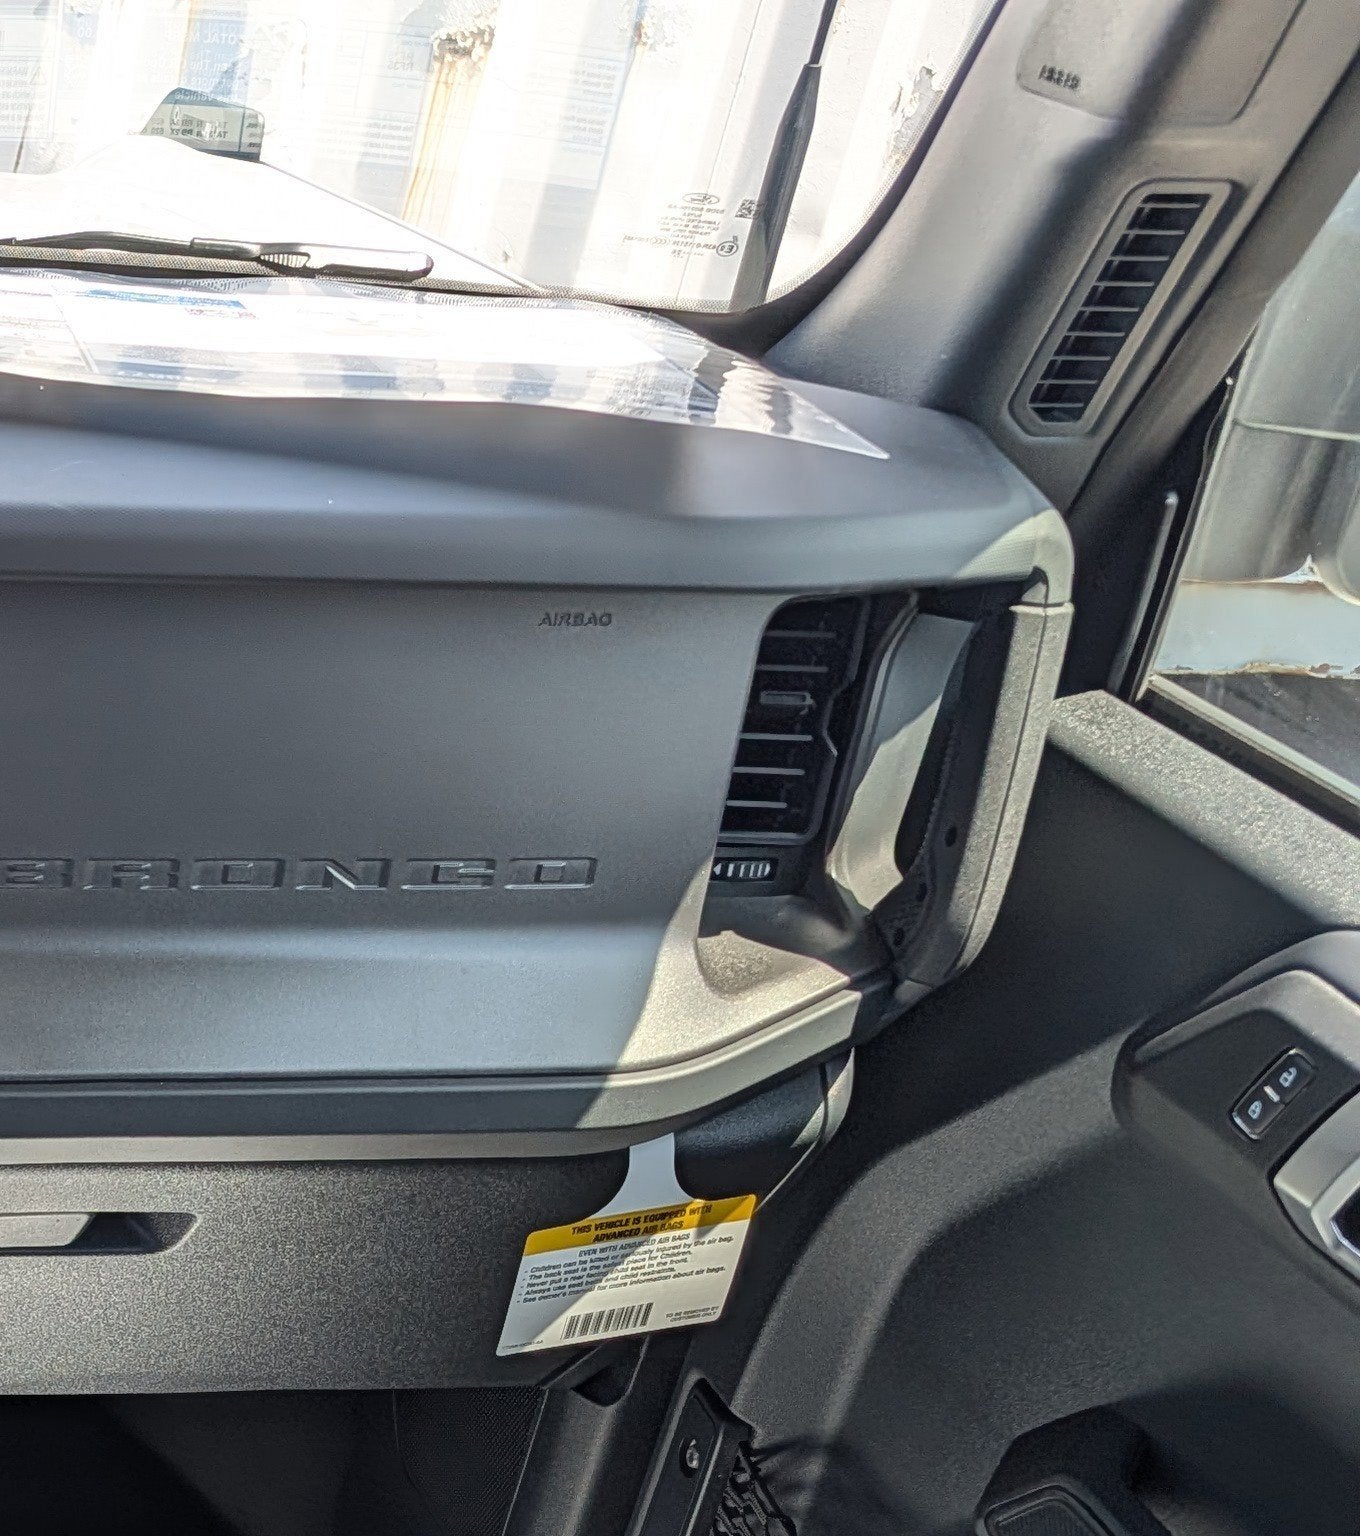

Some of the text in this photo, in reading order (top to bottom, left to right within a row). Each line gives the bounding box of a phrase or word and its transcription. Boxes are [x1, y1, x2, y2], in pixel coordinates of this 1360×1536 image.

[572, 1224, 592, 1236] THIS
[594, 1218, 630, 1232] VEHICLE
[632, 1216, 642, 1225] IS
[644, 1208, 686, 1223] EQUIPPED
[592, 1228, 640, 1243] ADVANCED
